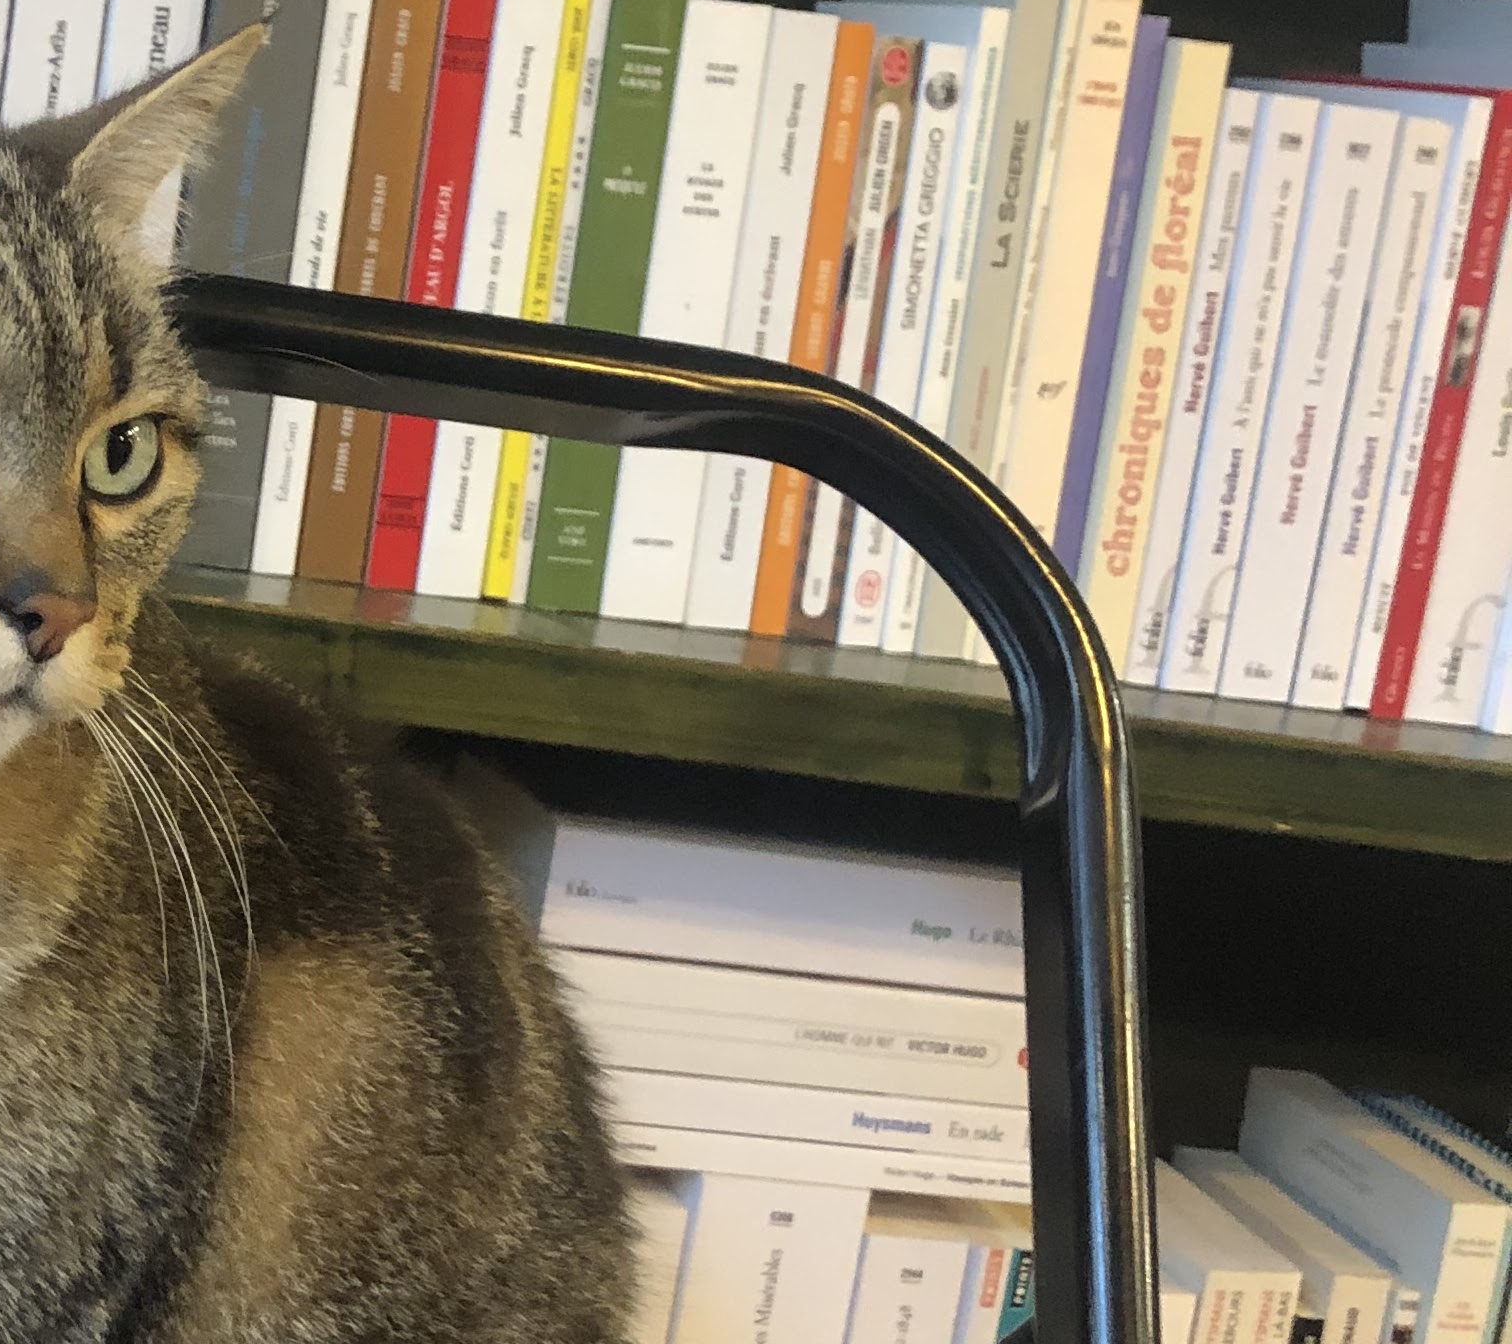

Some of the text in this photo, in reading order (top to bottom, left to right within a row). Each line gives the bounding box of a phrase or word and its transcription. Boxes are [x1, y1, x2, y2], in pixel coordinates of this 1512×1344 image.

[509, 45, 535, 138] Julien Gracq
[901, 127, 945, 331] SIMONETTA GREGGIO
[991, 119, 1031, 269] LA SCIERIE
[1102, 135, 1202, 578] chroniques de floréal
[1193, 291, 1221, 355] Guibert
[1183, 357, 1208, 414] Hervé
[1290, 404, 1319, 469] Guibert
[1211, 447, 1244, 557] Hervé Guibert
[1280, 469, 1306, 527] Hervé
[1341, 436, 1380, 557] Hervé Guibert
[908, 1038, 950, 1054] VICTOR
[852, 1112, 932, 1134] Huysmans
